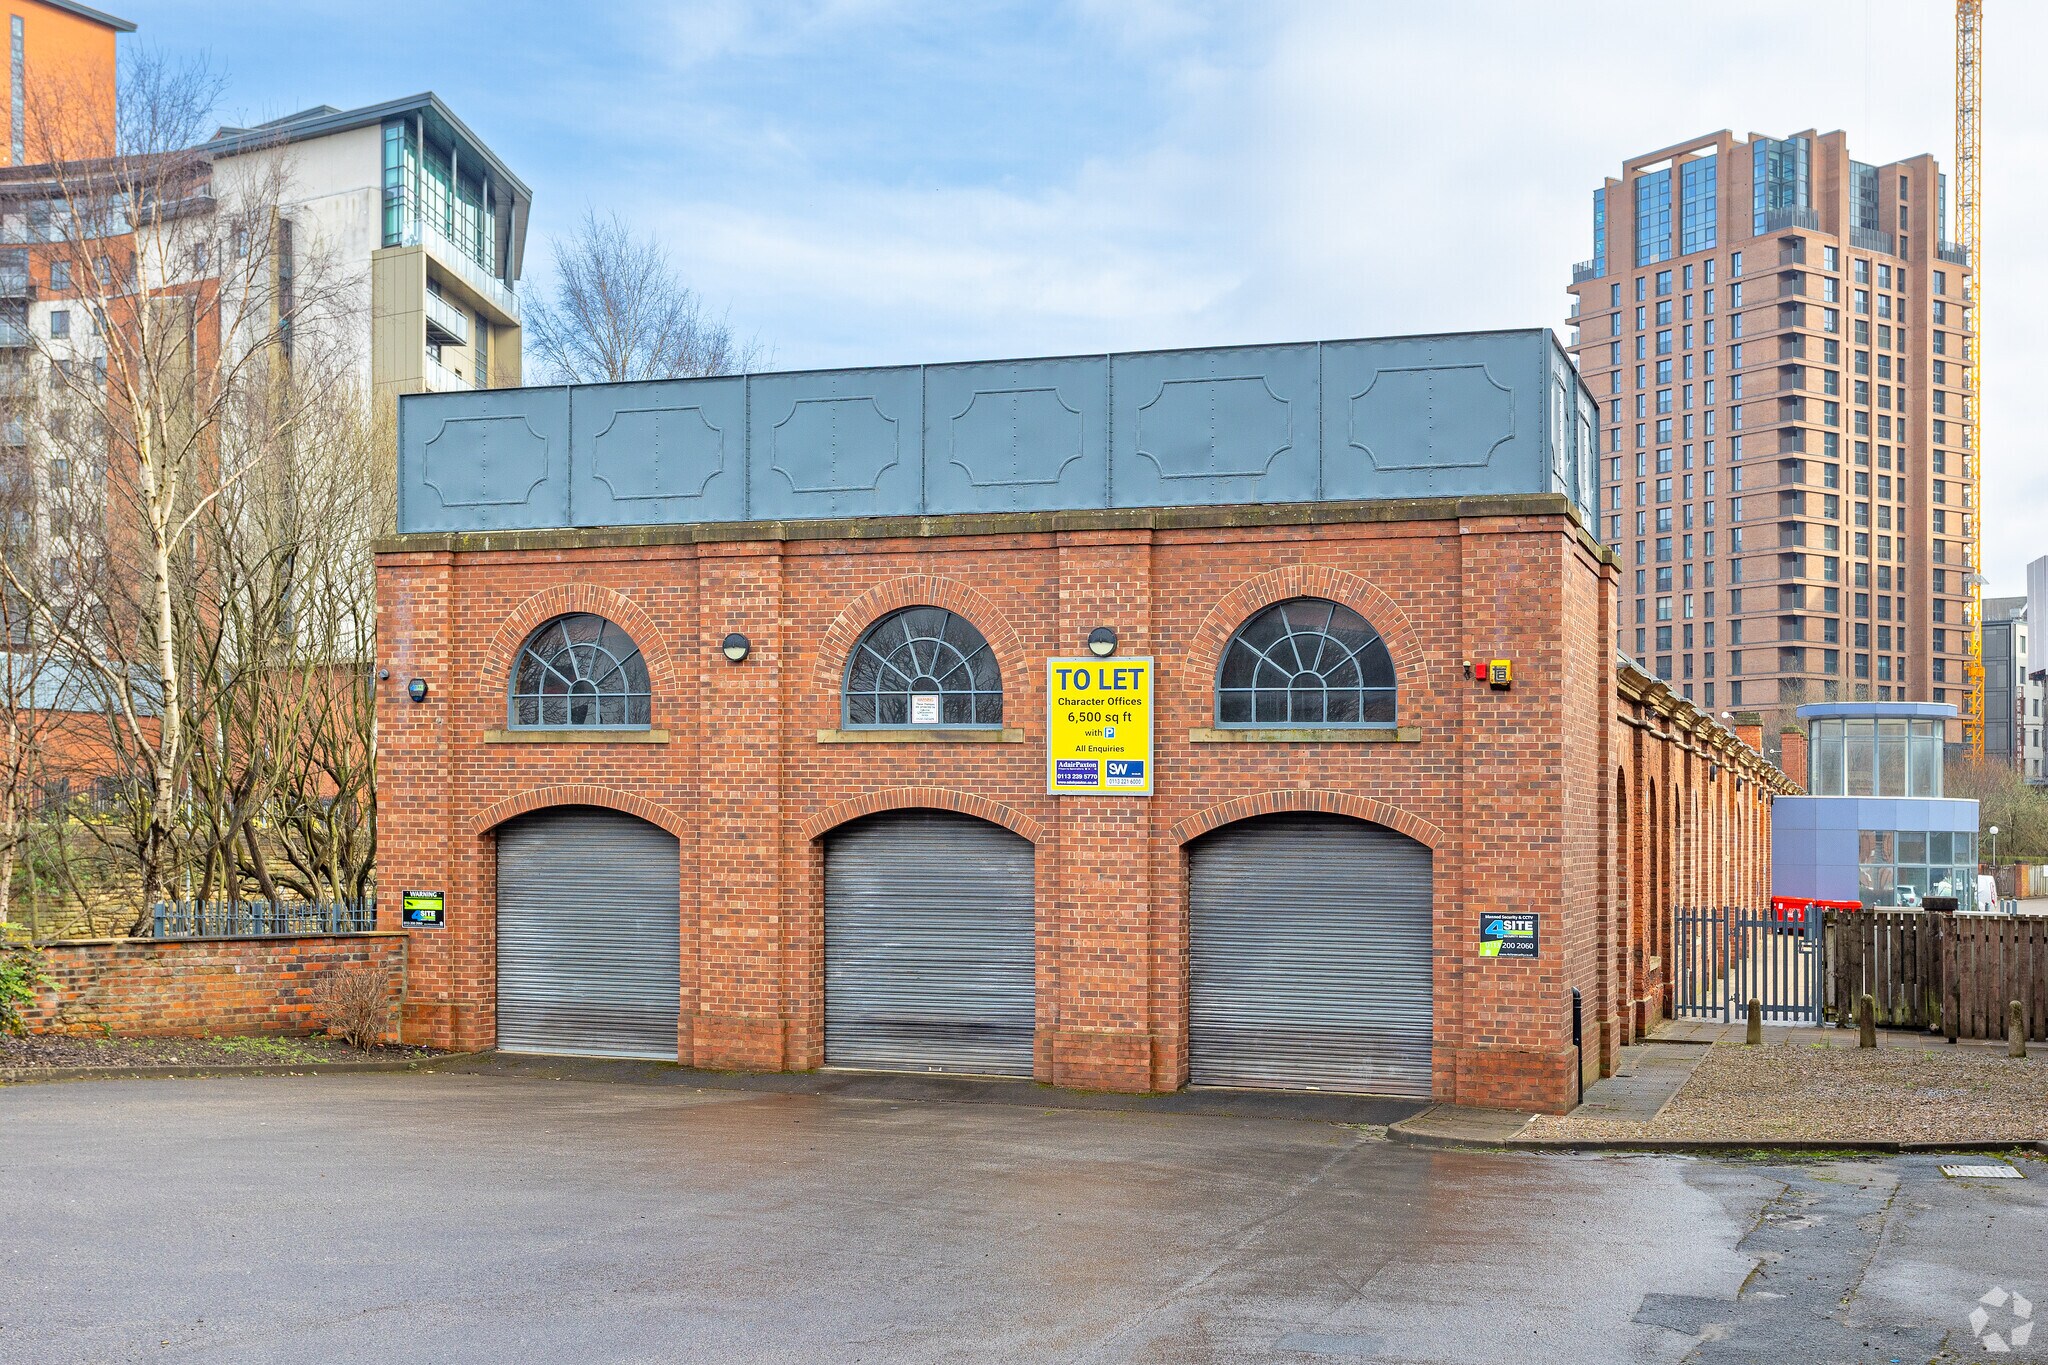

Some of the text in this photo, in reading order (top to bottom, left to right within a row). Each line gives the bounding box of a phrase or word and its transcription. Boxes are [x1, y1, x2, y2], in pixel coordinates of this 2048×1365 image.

[1056, 669, 1144, 690] TO LET
[1058, 697, 1142, 706] Character Offices
[1068, 712, 1132, 724] 6,500 sq ft
[1085, 729, 1102, 737] with
[1088, 745, 1125, 753] Enquiries
[1109, 763, 1127, 774] SW
